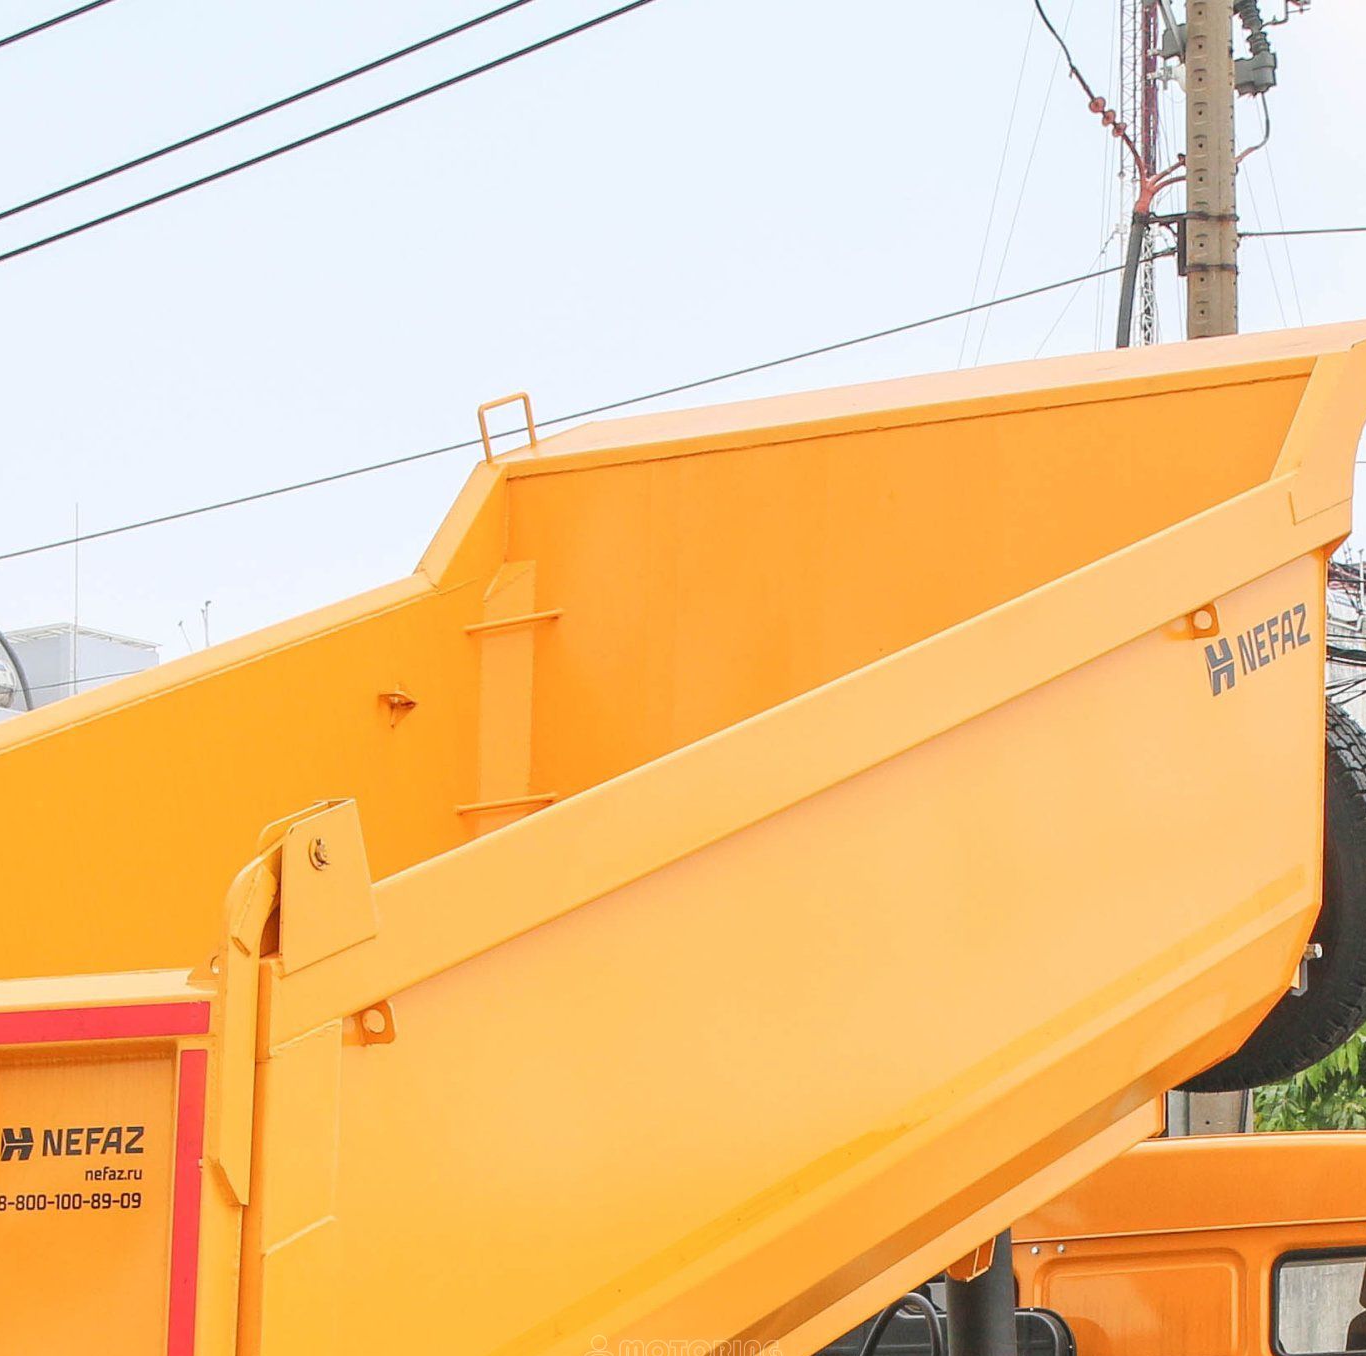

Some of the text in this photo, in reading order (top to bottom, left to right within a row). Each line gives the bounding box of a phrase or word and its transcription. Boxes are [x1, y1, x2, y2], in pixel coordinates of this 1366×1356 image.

[1237, 603, 1311, 676] NEFAZ
[42, 1126, 145, 1157] NEFAZ
[85, 1166, 143, 1181] nefaz.ru
